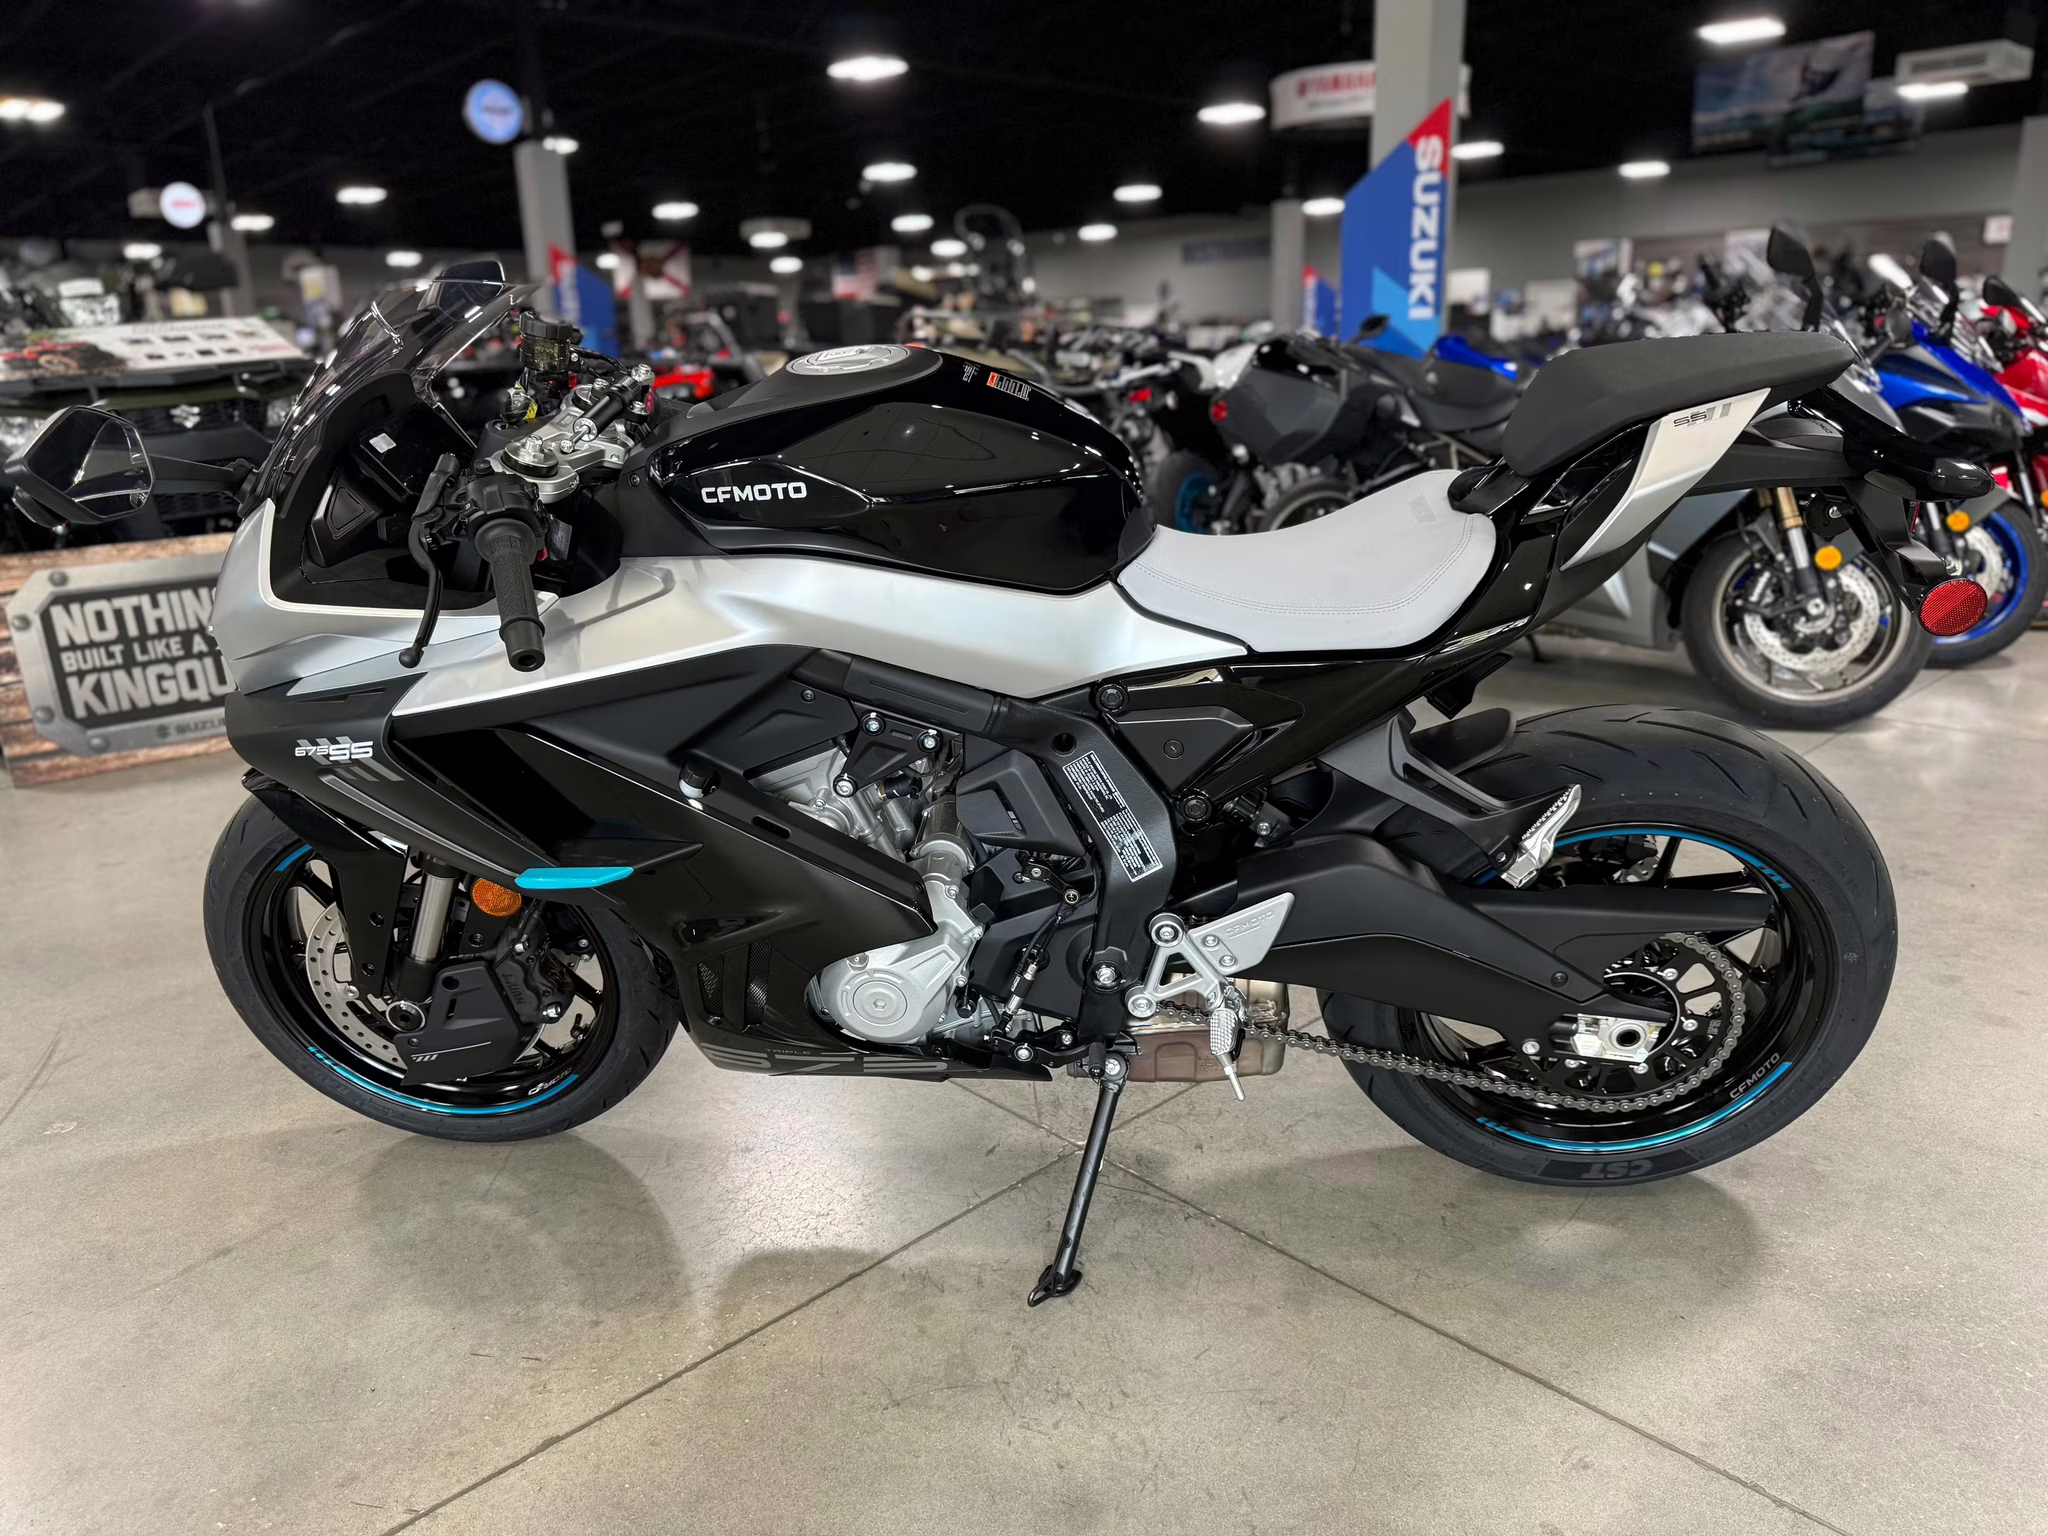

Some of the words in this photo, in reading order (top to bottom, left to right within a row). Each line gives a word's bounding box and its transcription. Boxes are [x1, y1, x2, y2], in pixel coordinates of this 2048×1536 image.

[1408, 134, 1444, 320] SUZUKI
[701, 482, 807, 503] CFMOTO
[50, 586, 216, 647] NOTHIN
[60, 644, 124, 672] BUILT
[133, 636, 184, 662] LIKE
[192, 633, 208, 654] A
[1730, 1053, 1780, 1098] CFMOTO
